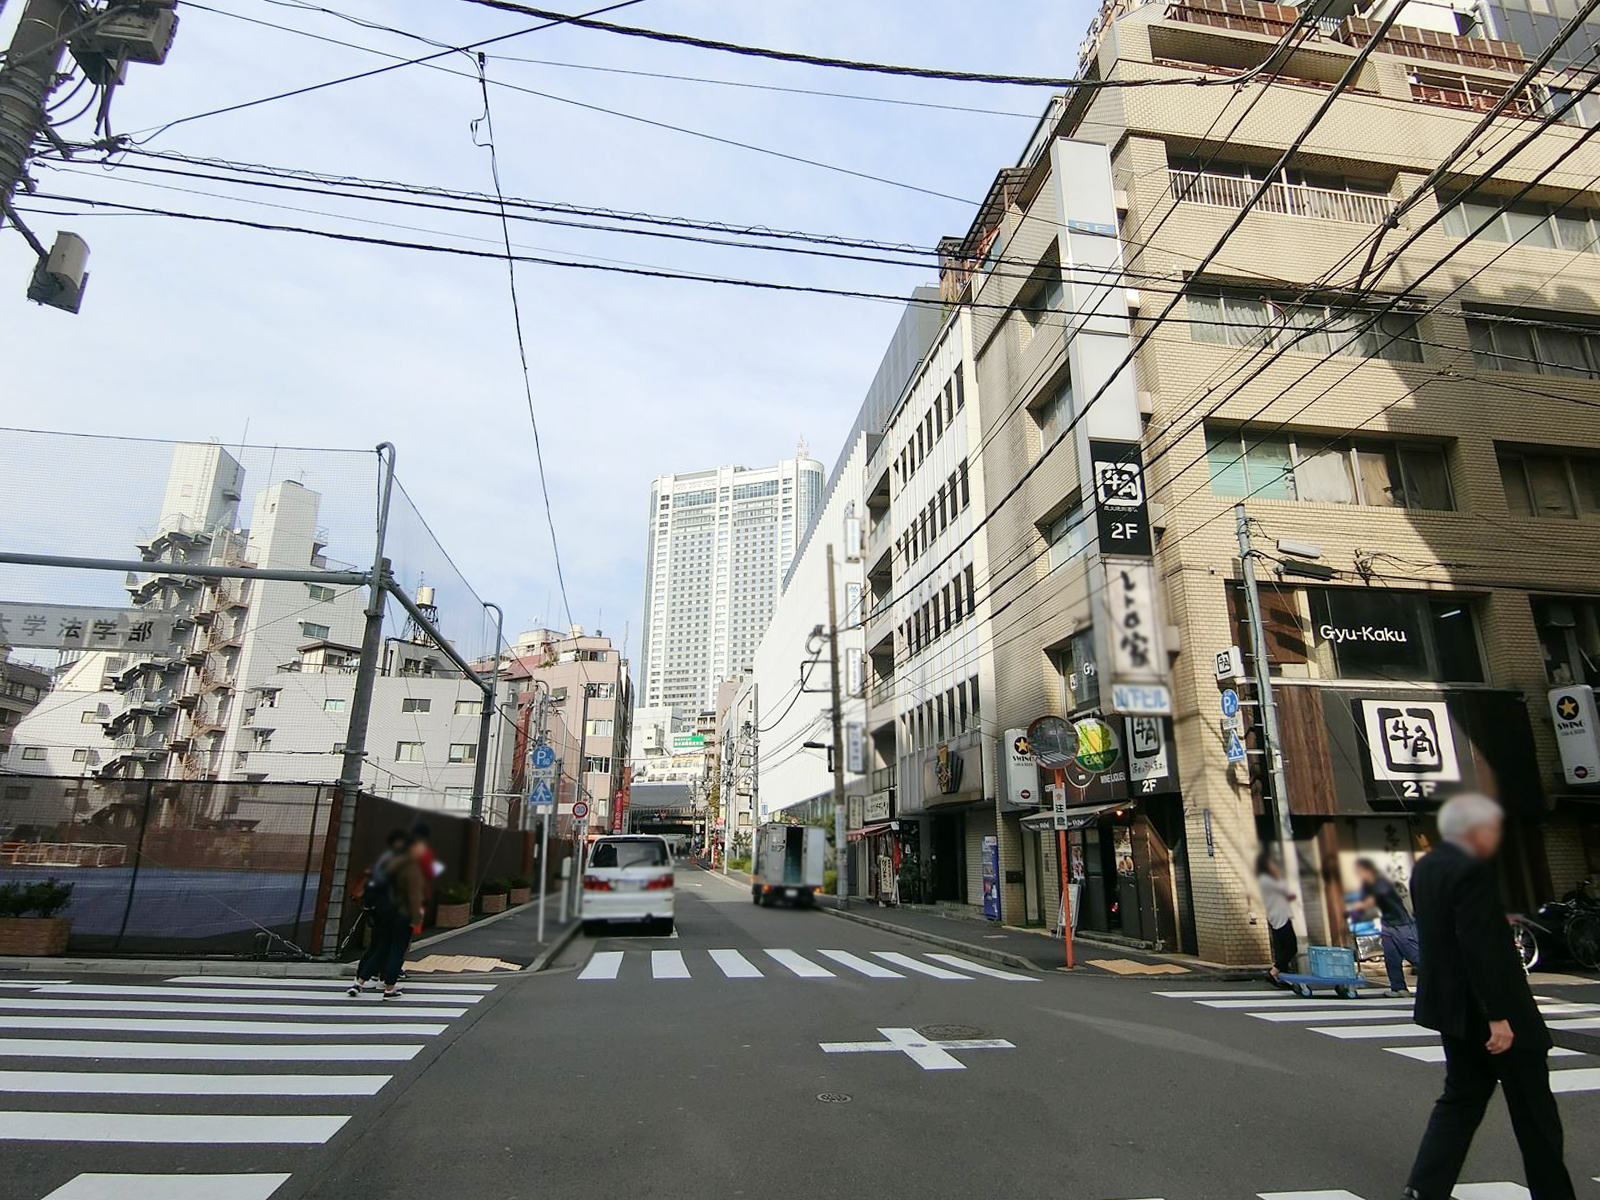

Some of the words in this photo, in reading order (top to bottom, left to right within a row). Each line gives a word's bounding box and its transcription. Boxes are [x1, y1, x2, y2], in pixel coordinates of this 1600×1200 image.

[1111, 522, 1138, 540] 2F
[1319, 625, 1408, 644] Gyu-Kaku
[536, 750, 547, 766] P
[1142, 779, 1157, 793] 2F
[1402, 781, 1437, 798] 2F
